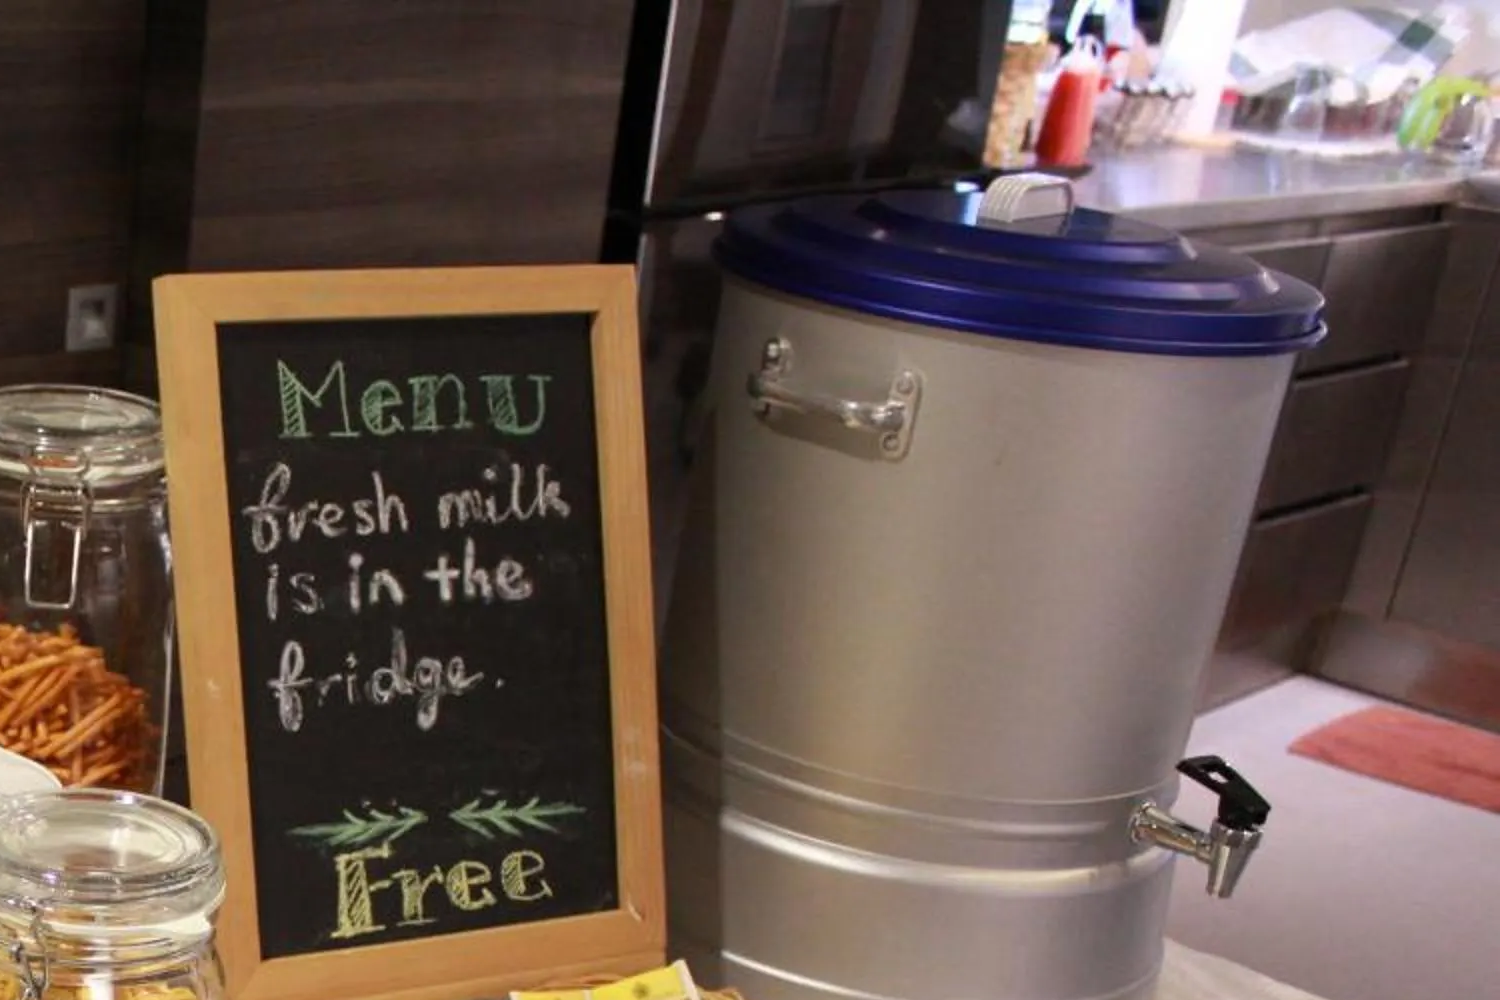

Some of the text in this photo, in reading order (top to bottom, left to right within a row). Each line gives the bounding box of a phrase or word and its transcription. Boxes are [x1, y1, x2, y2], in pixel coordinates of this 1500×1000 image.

[277, 360, 551, 437] Menu
[242, 463, 571, 554] fresh milk
[266, 536, 535, 621] is in the
[267, 626, 505, 732] fridge.
[330, 848, 553, 939] Free
